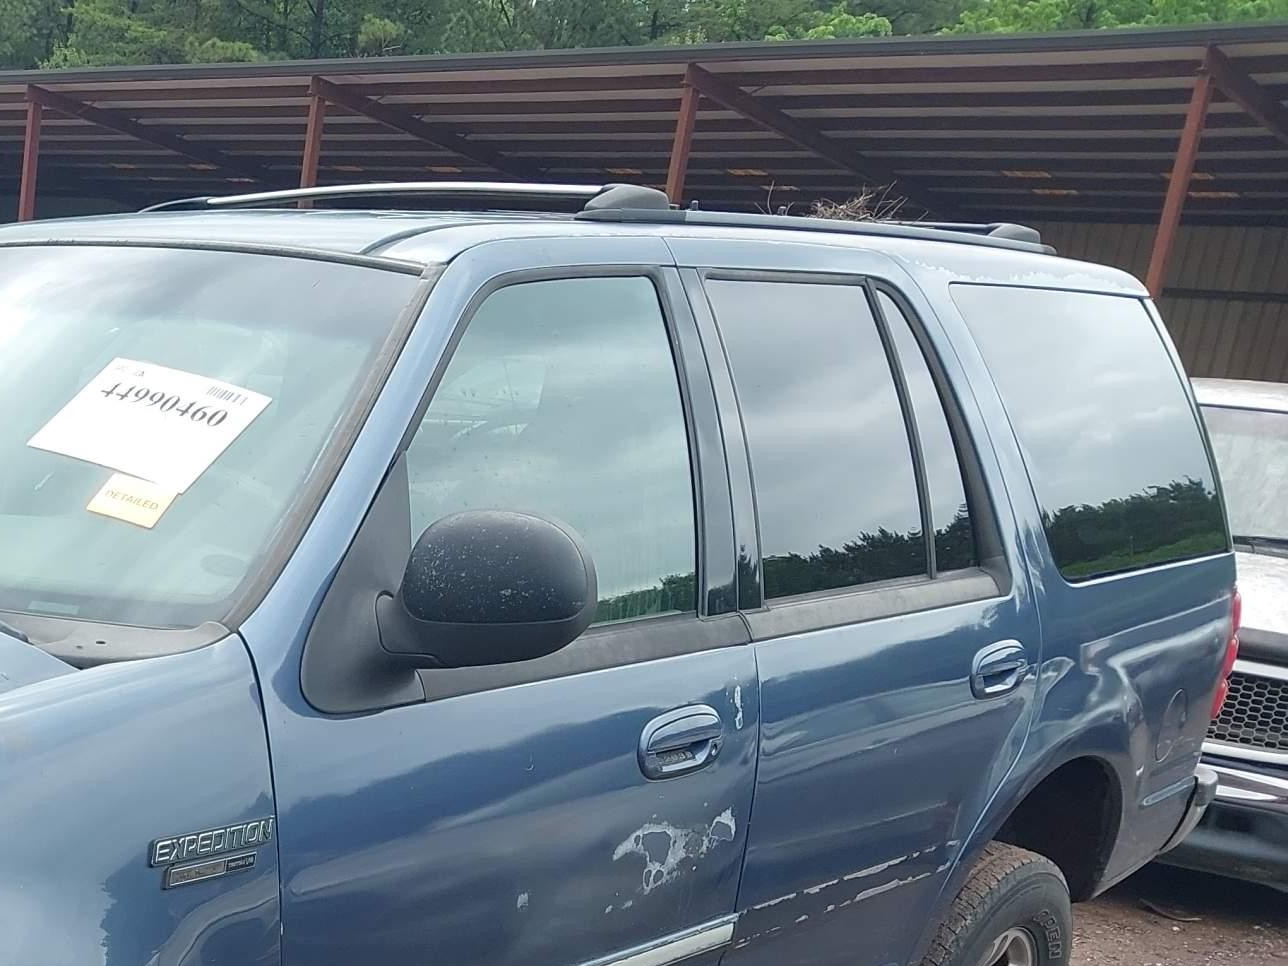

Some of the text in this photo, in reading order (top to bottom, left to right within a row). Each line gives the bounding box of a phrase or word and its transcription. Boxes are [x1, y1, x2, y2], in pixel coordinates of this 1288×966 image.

[101, 382, 229, 427] 44990460
[105, 489, 159, 511] DETAILED
[155, 818, 273, 862] EXPEDITION
[1033, 909, 1062, 959] OPEN
